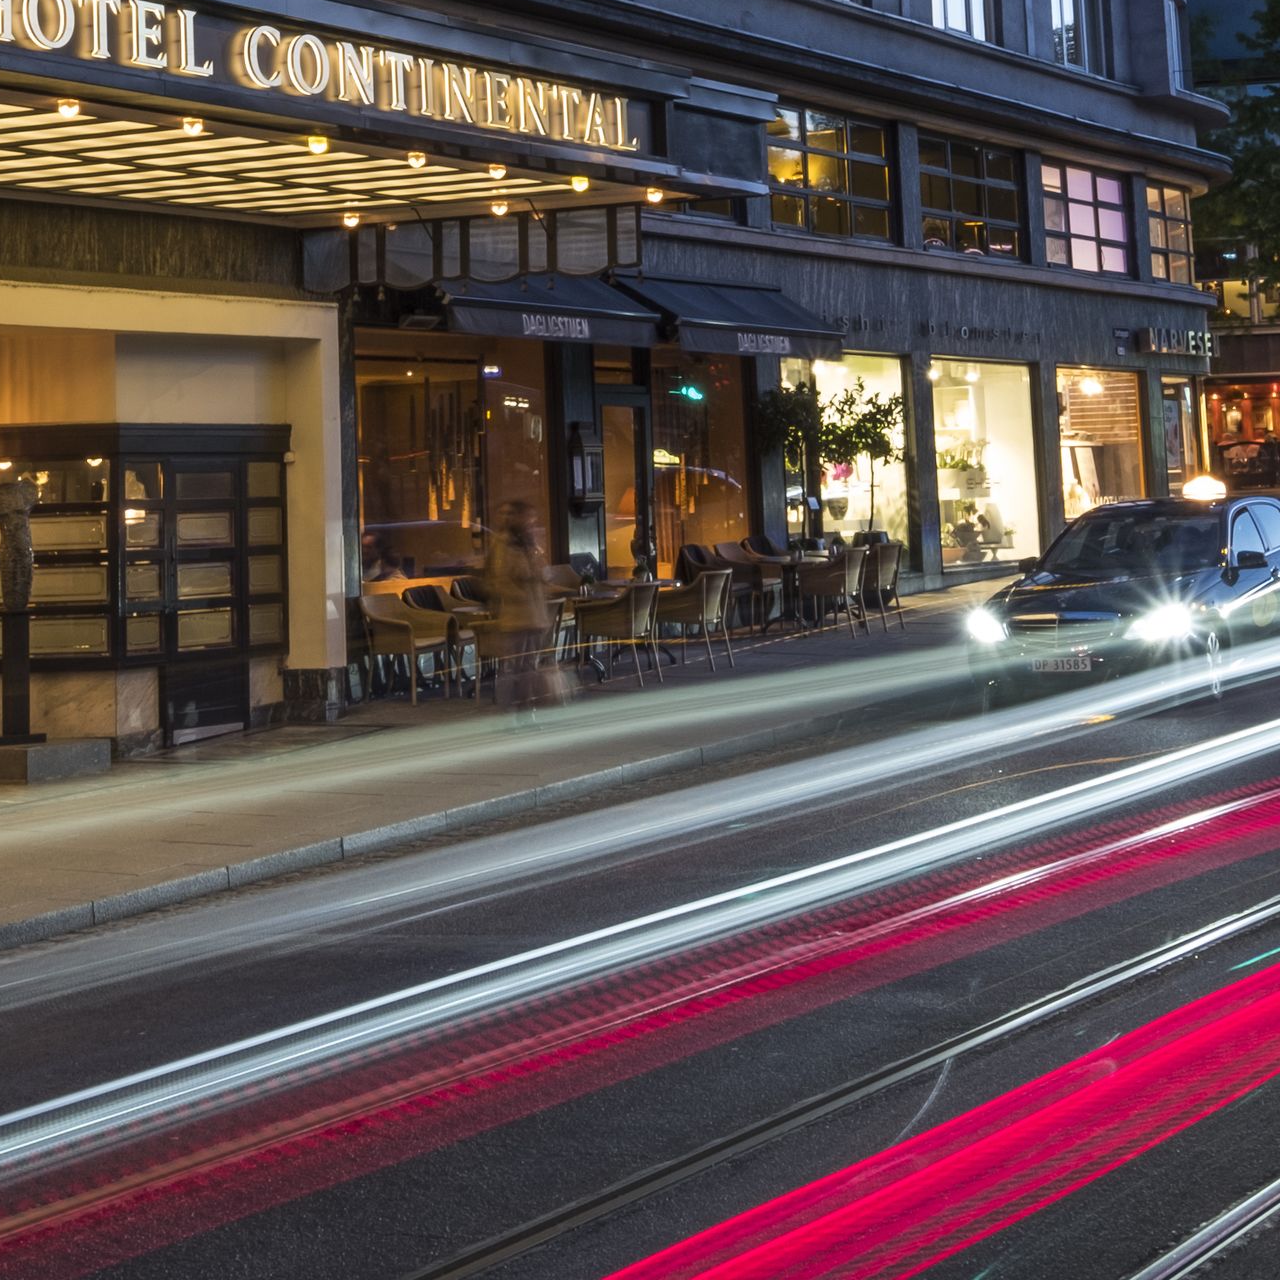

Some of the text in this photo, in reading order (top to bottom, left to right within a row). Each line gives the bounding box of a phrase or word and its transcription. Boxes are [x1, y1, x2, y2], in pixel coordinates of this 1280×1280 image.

[242, 24, 641, 152] CONTINENTAL
[521, 313, 590, 339] DAGLIGSTUEN
[1148, 327, 1220, 359] NARVESEN
[1053, 658, 1088, 671] 31585
